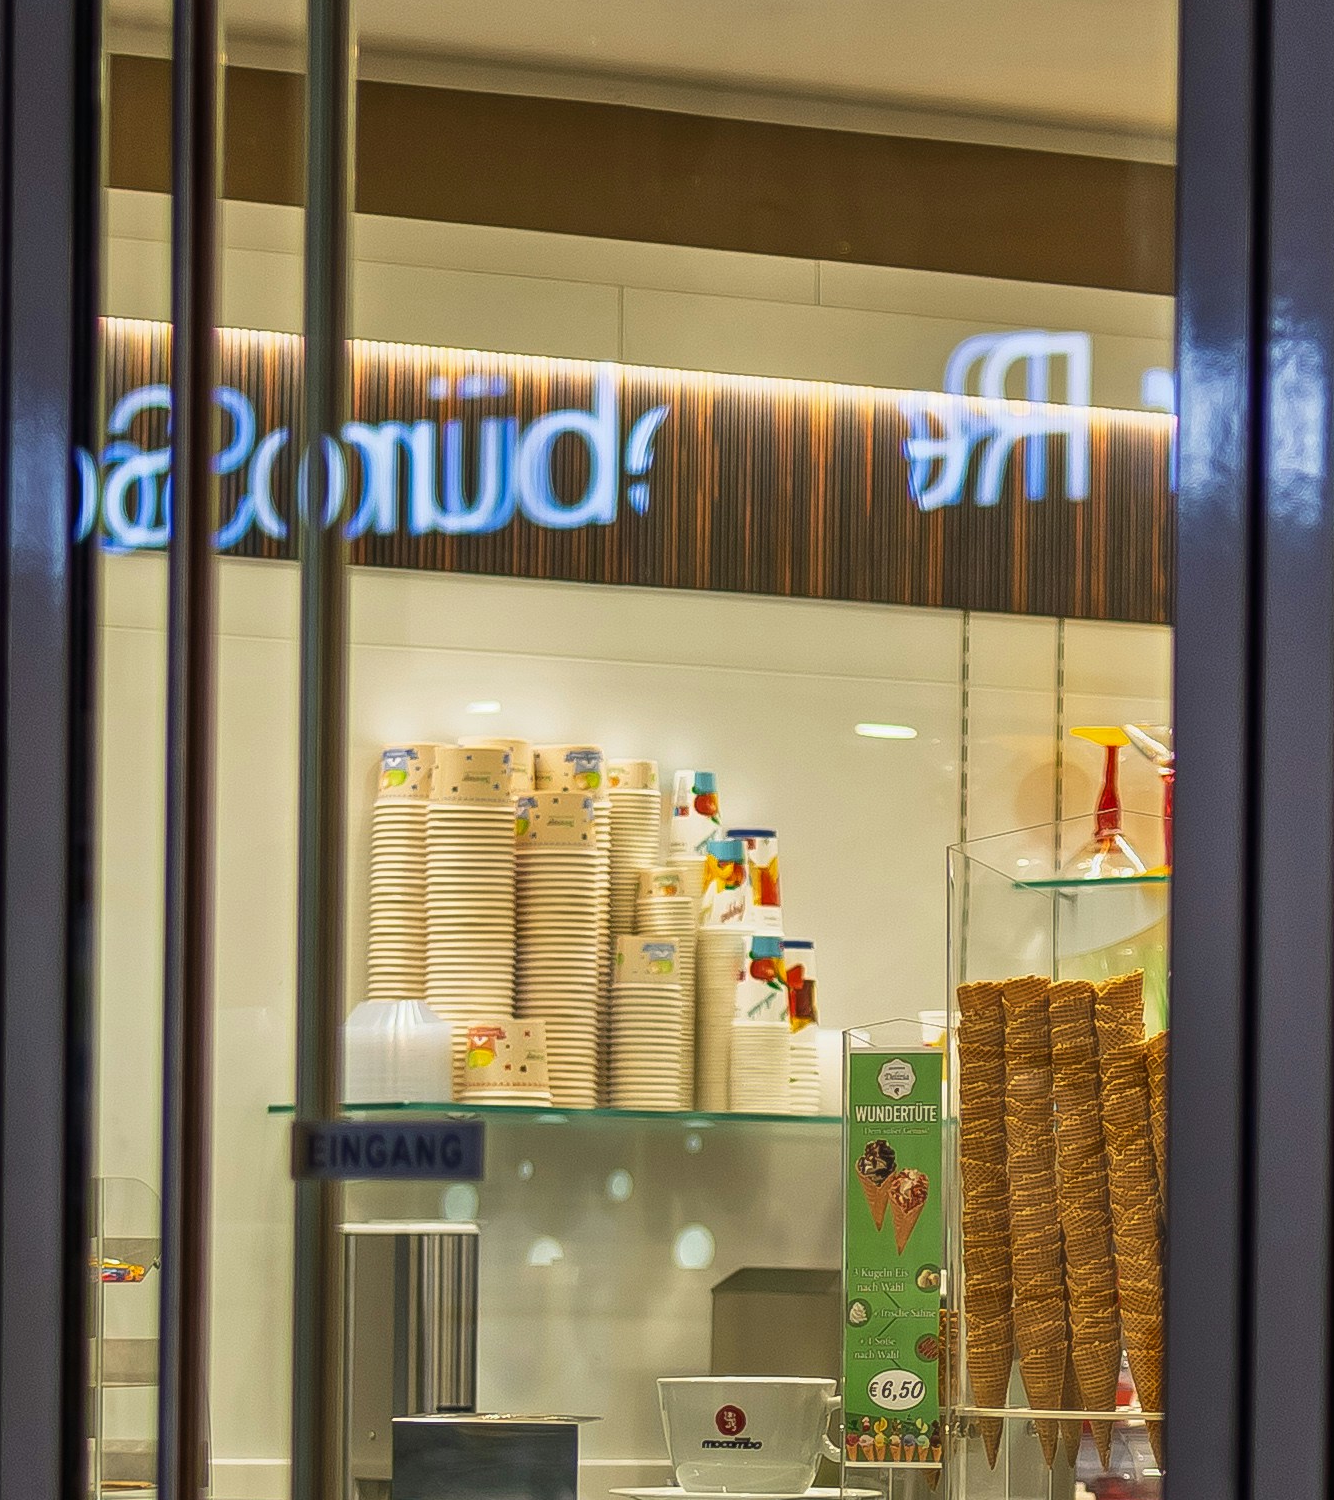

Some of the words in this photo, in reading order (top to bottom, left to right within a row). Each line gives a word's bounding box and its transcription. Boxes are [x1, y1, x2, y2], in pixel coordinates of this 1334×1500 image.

[855, 1102, 937, 1122] WUNDERTÜTE
[308, 1133, 462, 1169] EINGANG
[861, 1268, 892, 1279] Kugeln
[895, 1268, 909, 1277] Eis
[857, 1283, 878, 1291] nach
[882, 1282, 904, 1291] Wahl
[870, 1381, 878, 1397] €
[882, 1381, 924, 1401] 6,50
